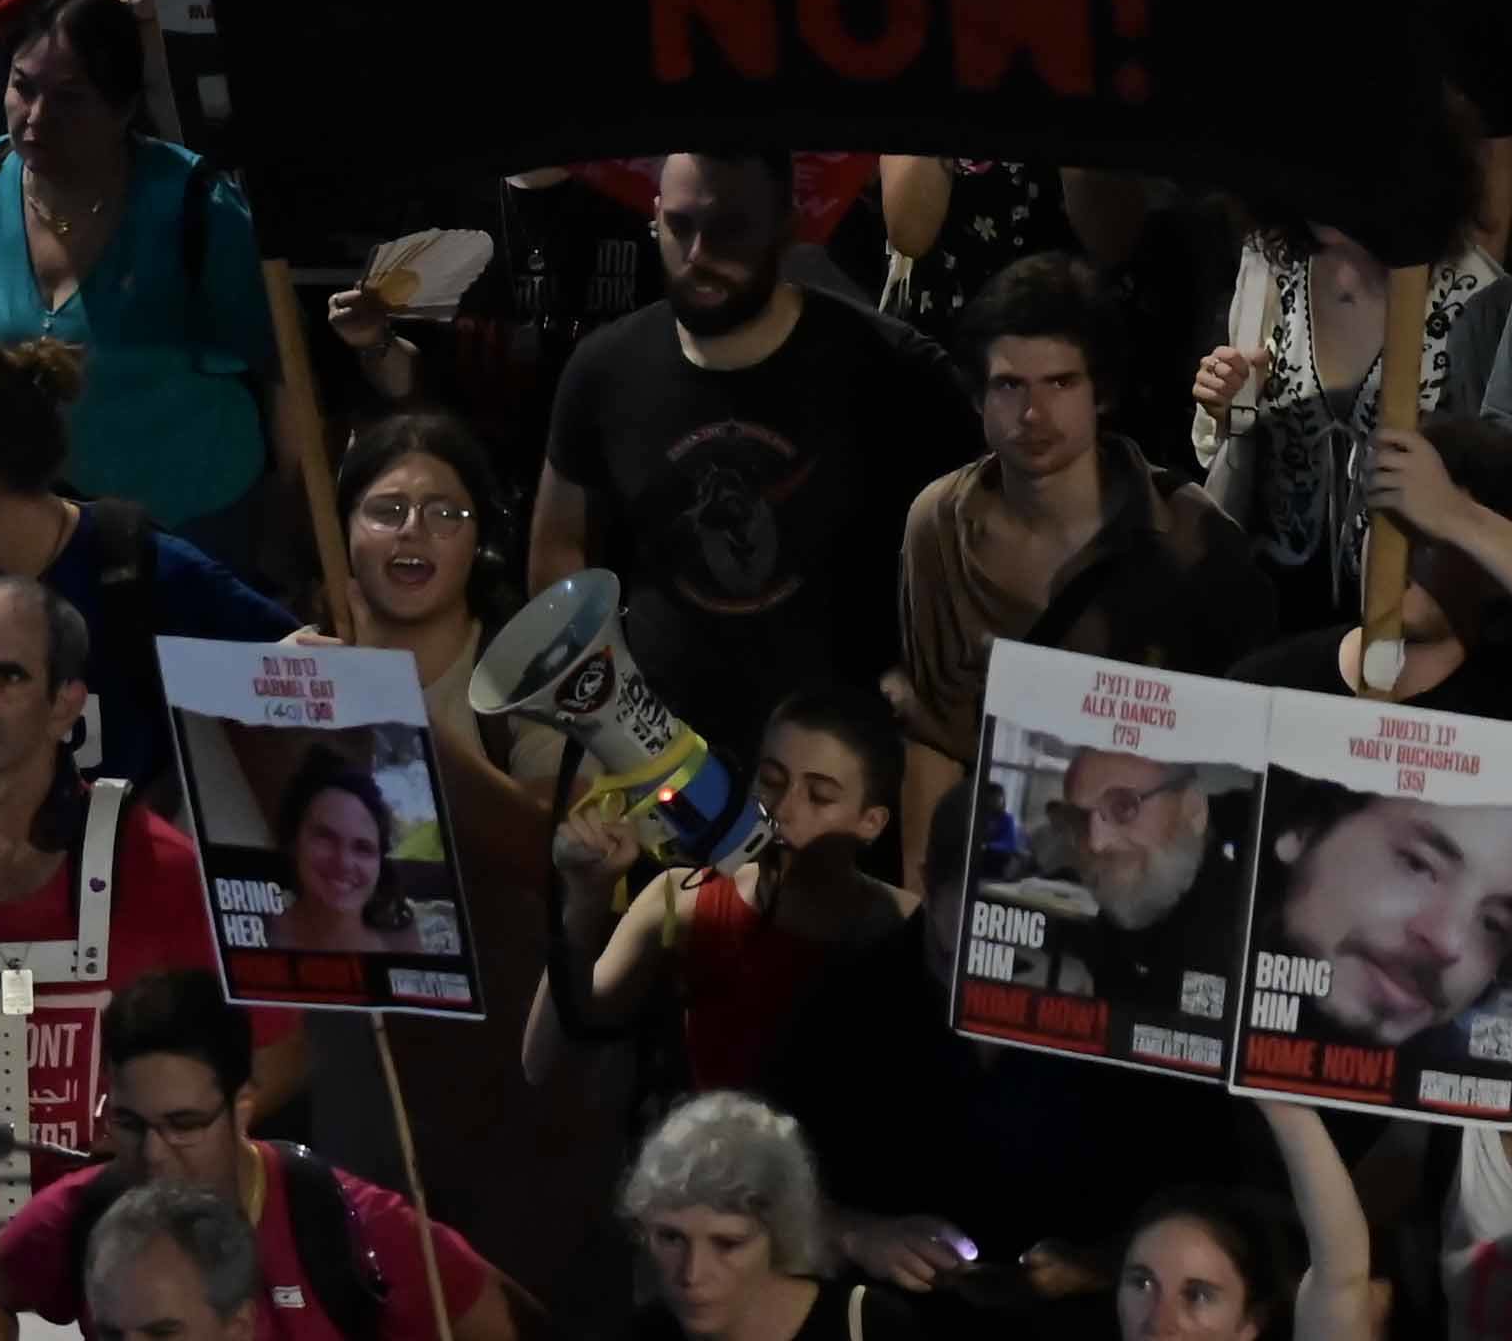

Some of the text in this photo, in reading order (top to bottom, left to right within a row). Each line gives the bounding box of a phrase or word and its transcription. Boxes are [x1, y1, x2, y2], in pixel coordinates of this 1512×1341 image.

[1081, 693, 1176, 731] ALEX DANCYG
[1112, 723, 1141, 751] (75)
[1397, 768, 1425, 792] (35)
[217, 879, 285, 915] BRING
[222, 914, 269, 949] HER
[971, 900, 1047, 951] BRING
[966, 937, 1016, 983] HIM
[1256, 950, 1331, 999] BRING
[1249, 989, 1300, 1035] HIM
[1248, 1033, 1320, 1077] HOME
[1322, 1045, 1397, 1088] NOW!
